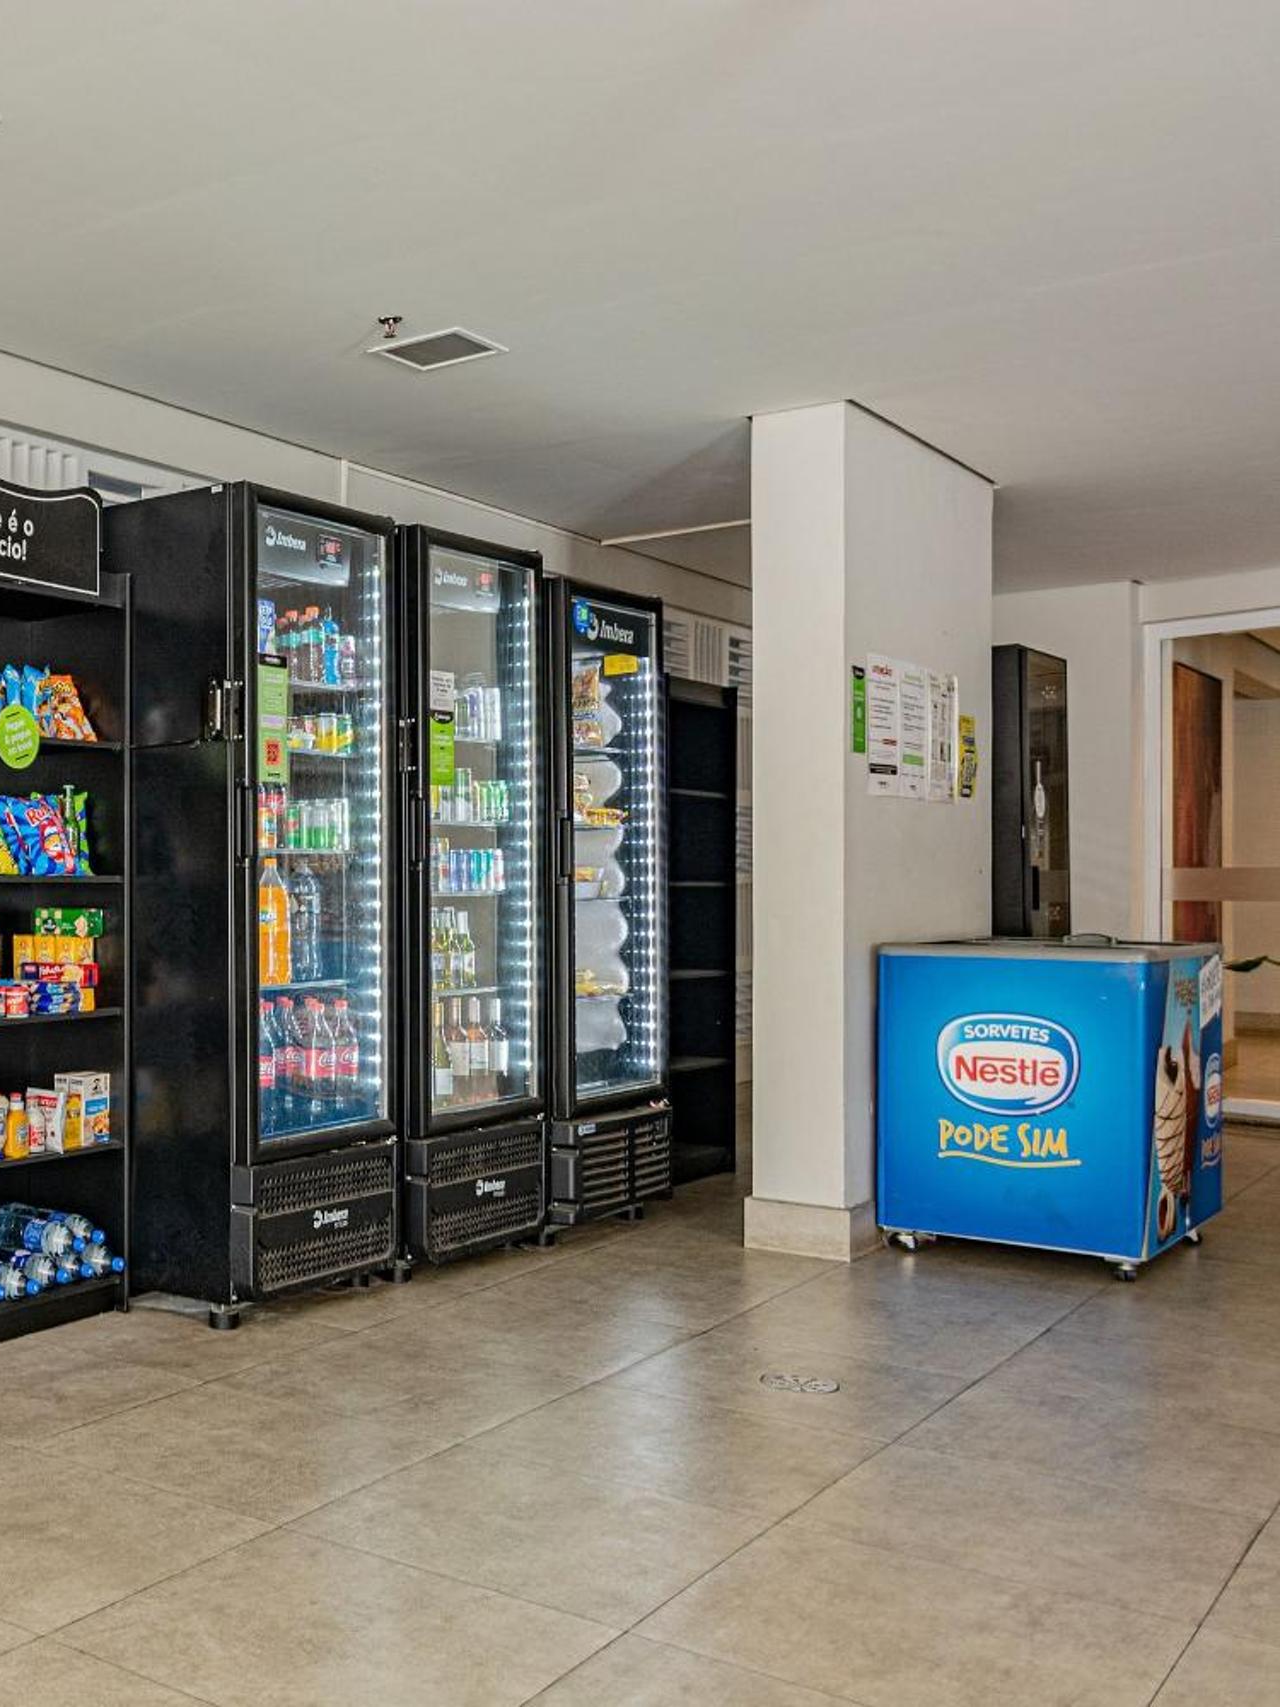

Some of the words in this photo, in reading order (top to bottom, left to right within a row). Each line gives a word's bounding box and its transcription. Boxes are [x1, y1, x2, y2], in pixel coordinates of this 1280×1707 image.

[8, 509, 19, 532] é
[24, 521, 35, 537] o
[963, 1023, 1050, 1044] SORVETES
[937, 1119, 1010, 1154] PODE
[1016, 1122, 1069, 1158] SIM
